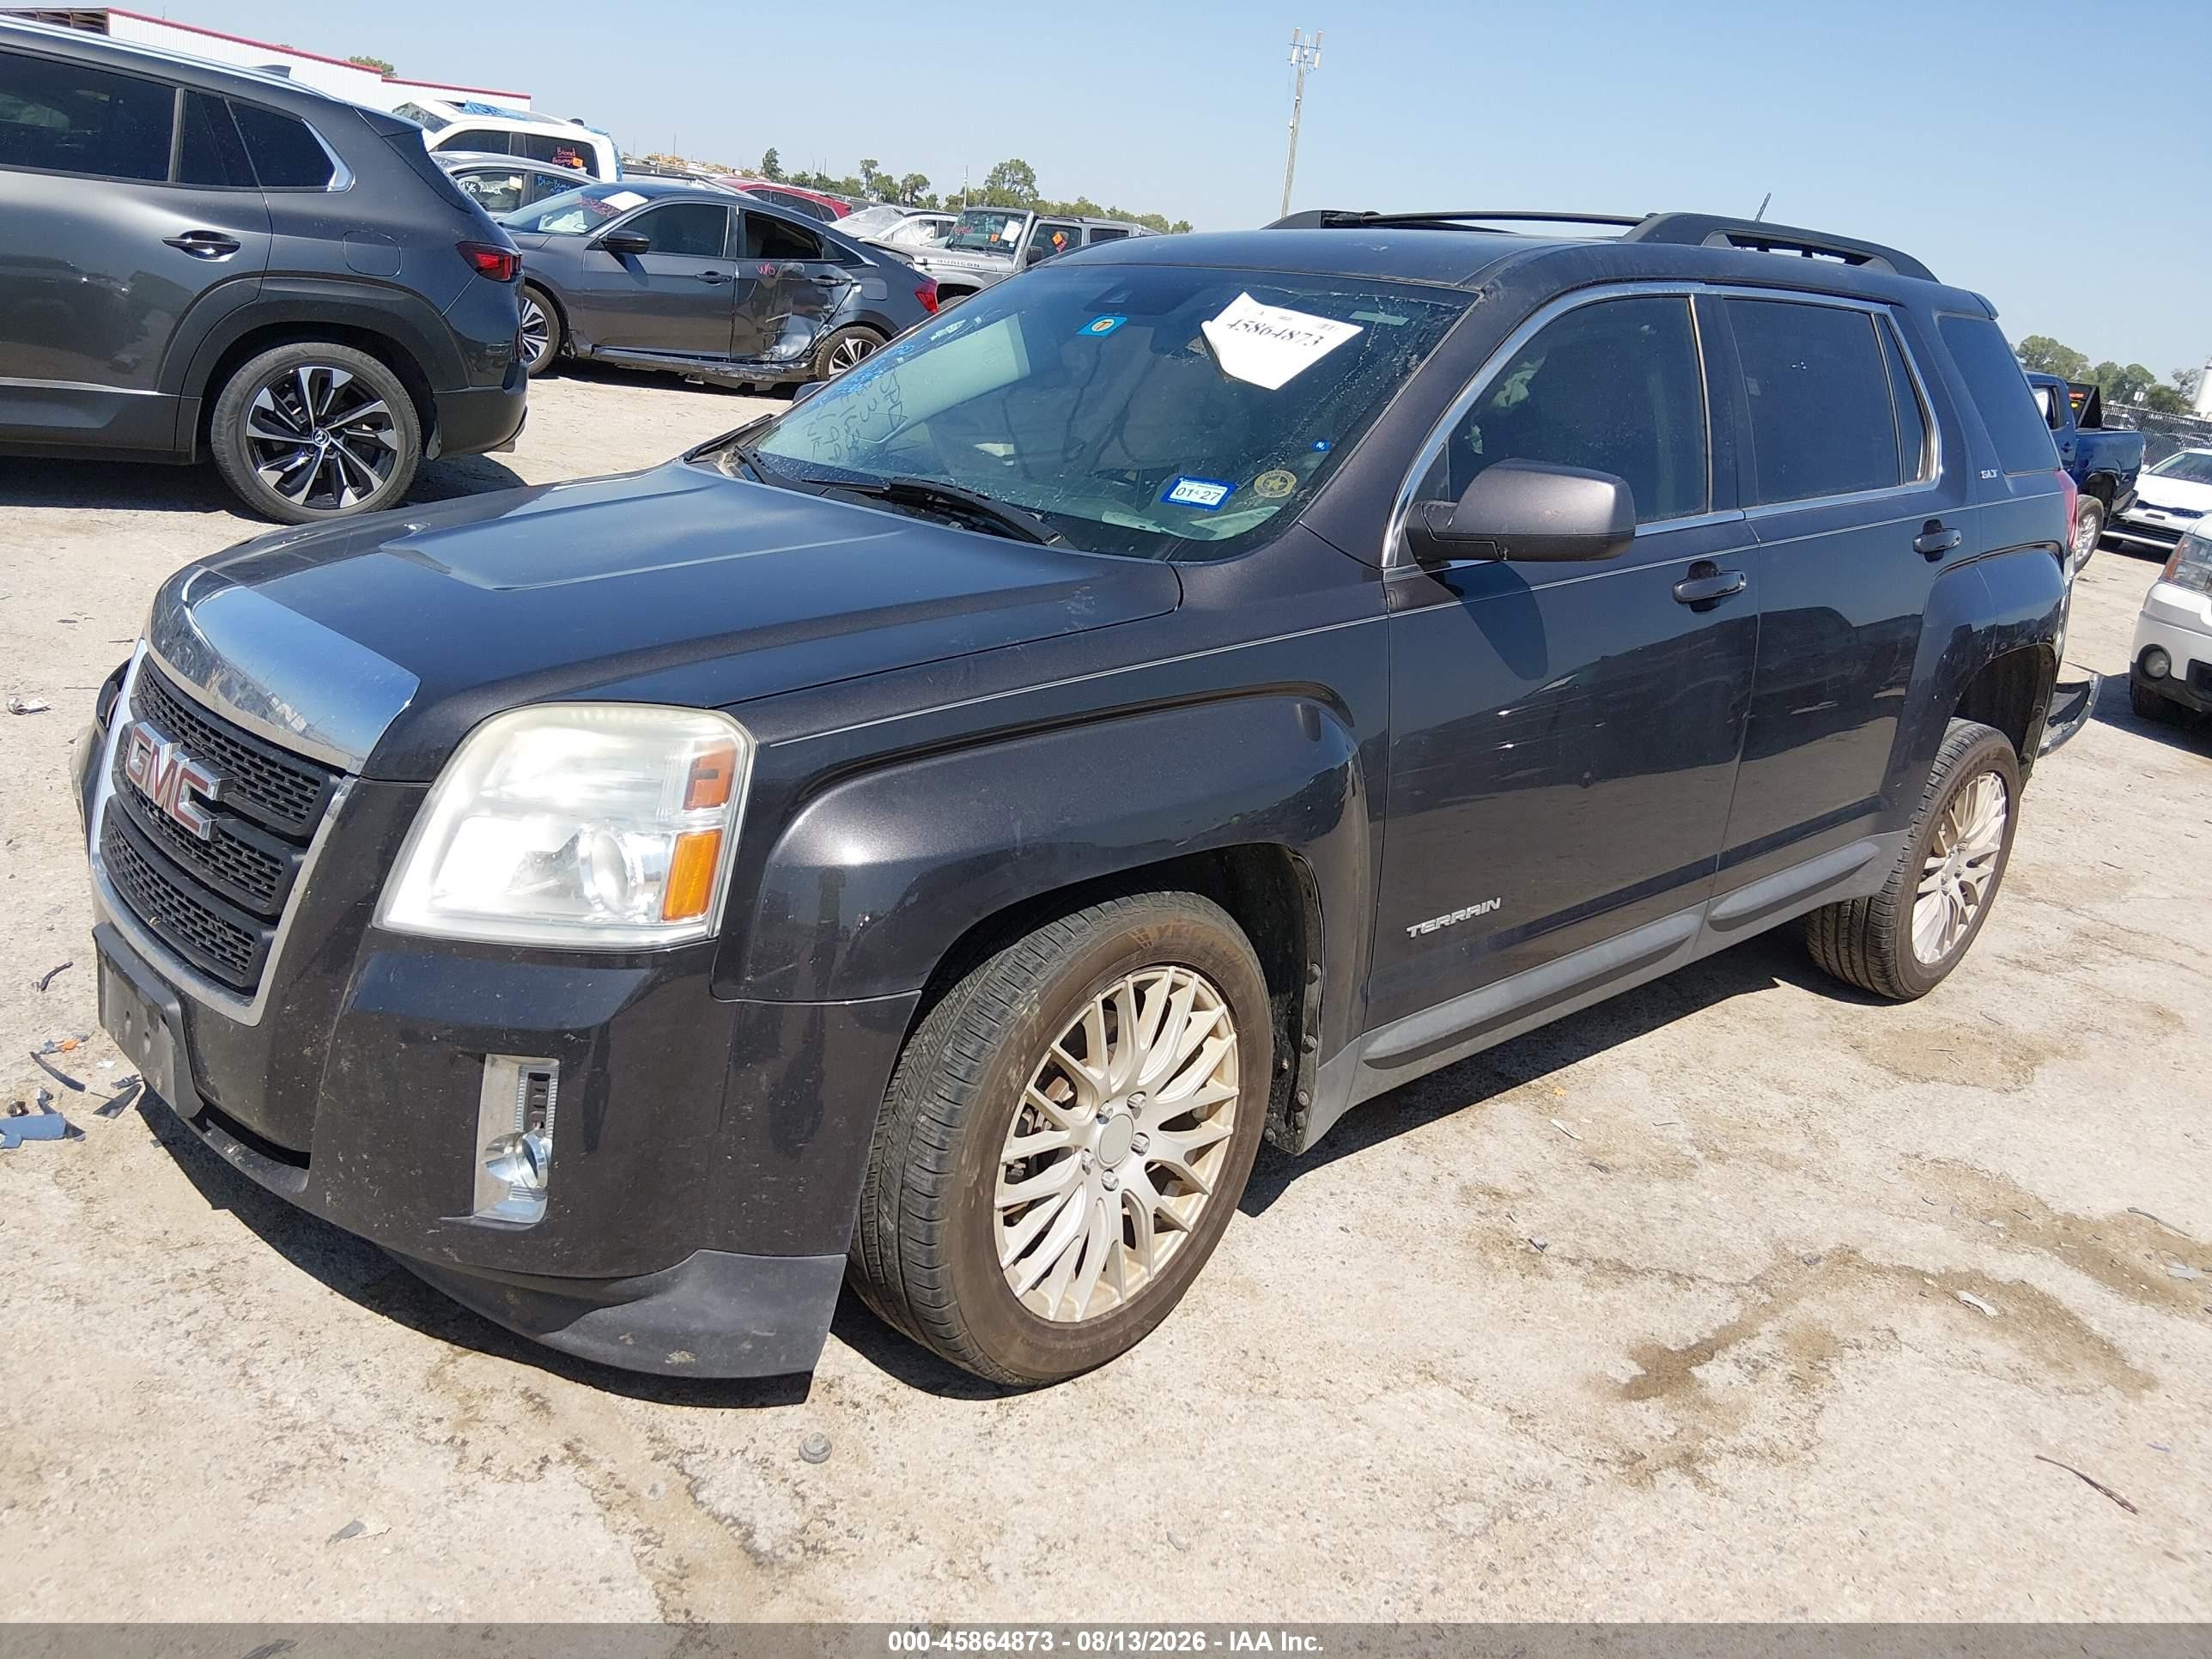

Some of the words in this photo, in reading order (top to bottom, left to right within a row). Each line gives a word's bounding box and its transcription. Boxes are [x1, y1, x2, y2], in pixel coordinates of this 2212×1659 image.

[1226, 318, 1326, 347] 45864873
[1175, 487, 1194, 497] 01
[1199, 490, 1221, 501] 27
[126, 722, 221, 840] GMC
[1406, 897, 1501, 938] TERRAIN
